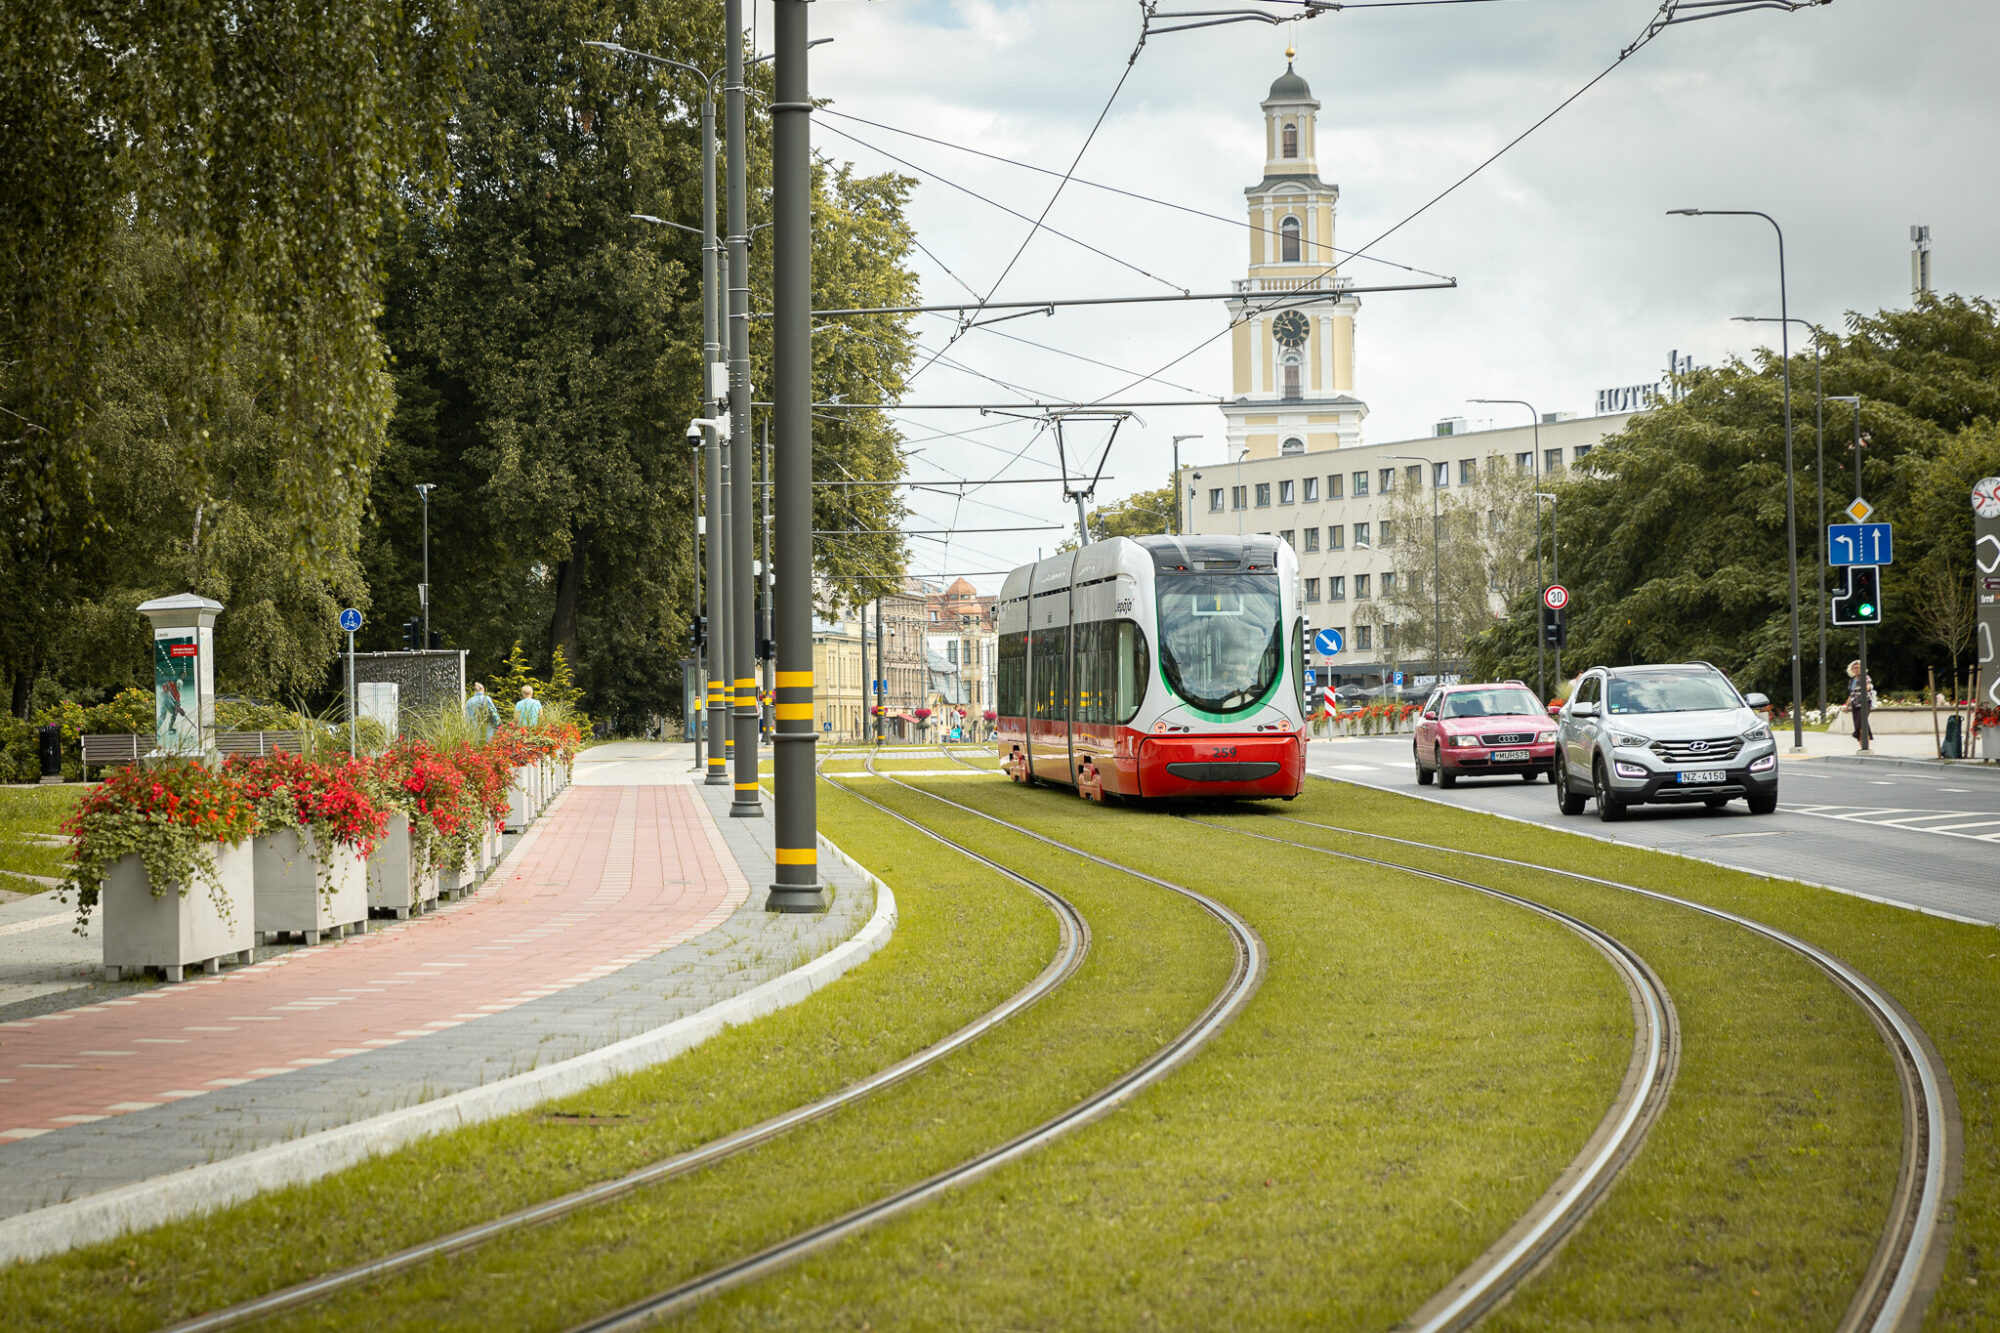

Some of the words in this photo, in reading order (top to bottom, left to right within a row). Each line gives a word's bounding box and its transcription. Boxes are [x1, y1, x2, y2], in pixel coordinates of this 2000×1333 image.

[1213, 594, 1221, 610] 1
[1551, 591, 1562, 603] 30
[1212, 747, 1237, 758] 259
[1683, 771, 1725, 781] NZ-4150
